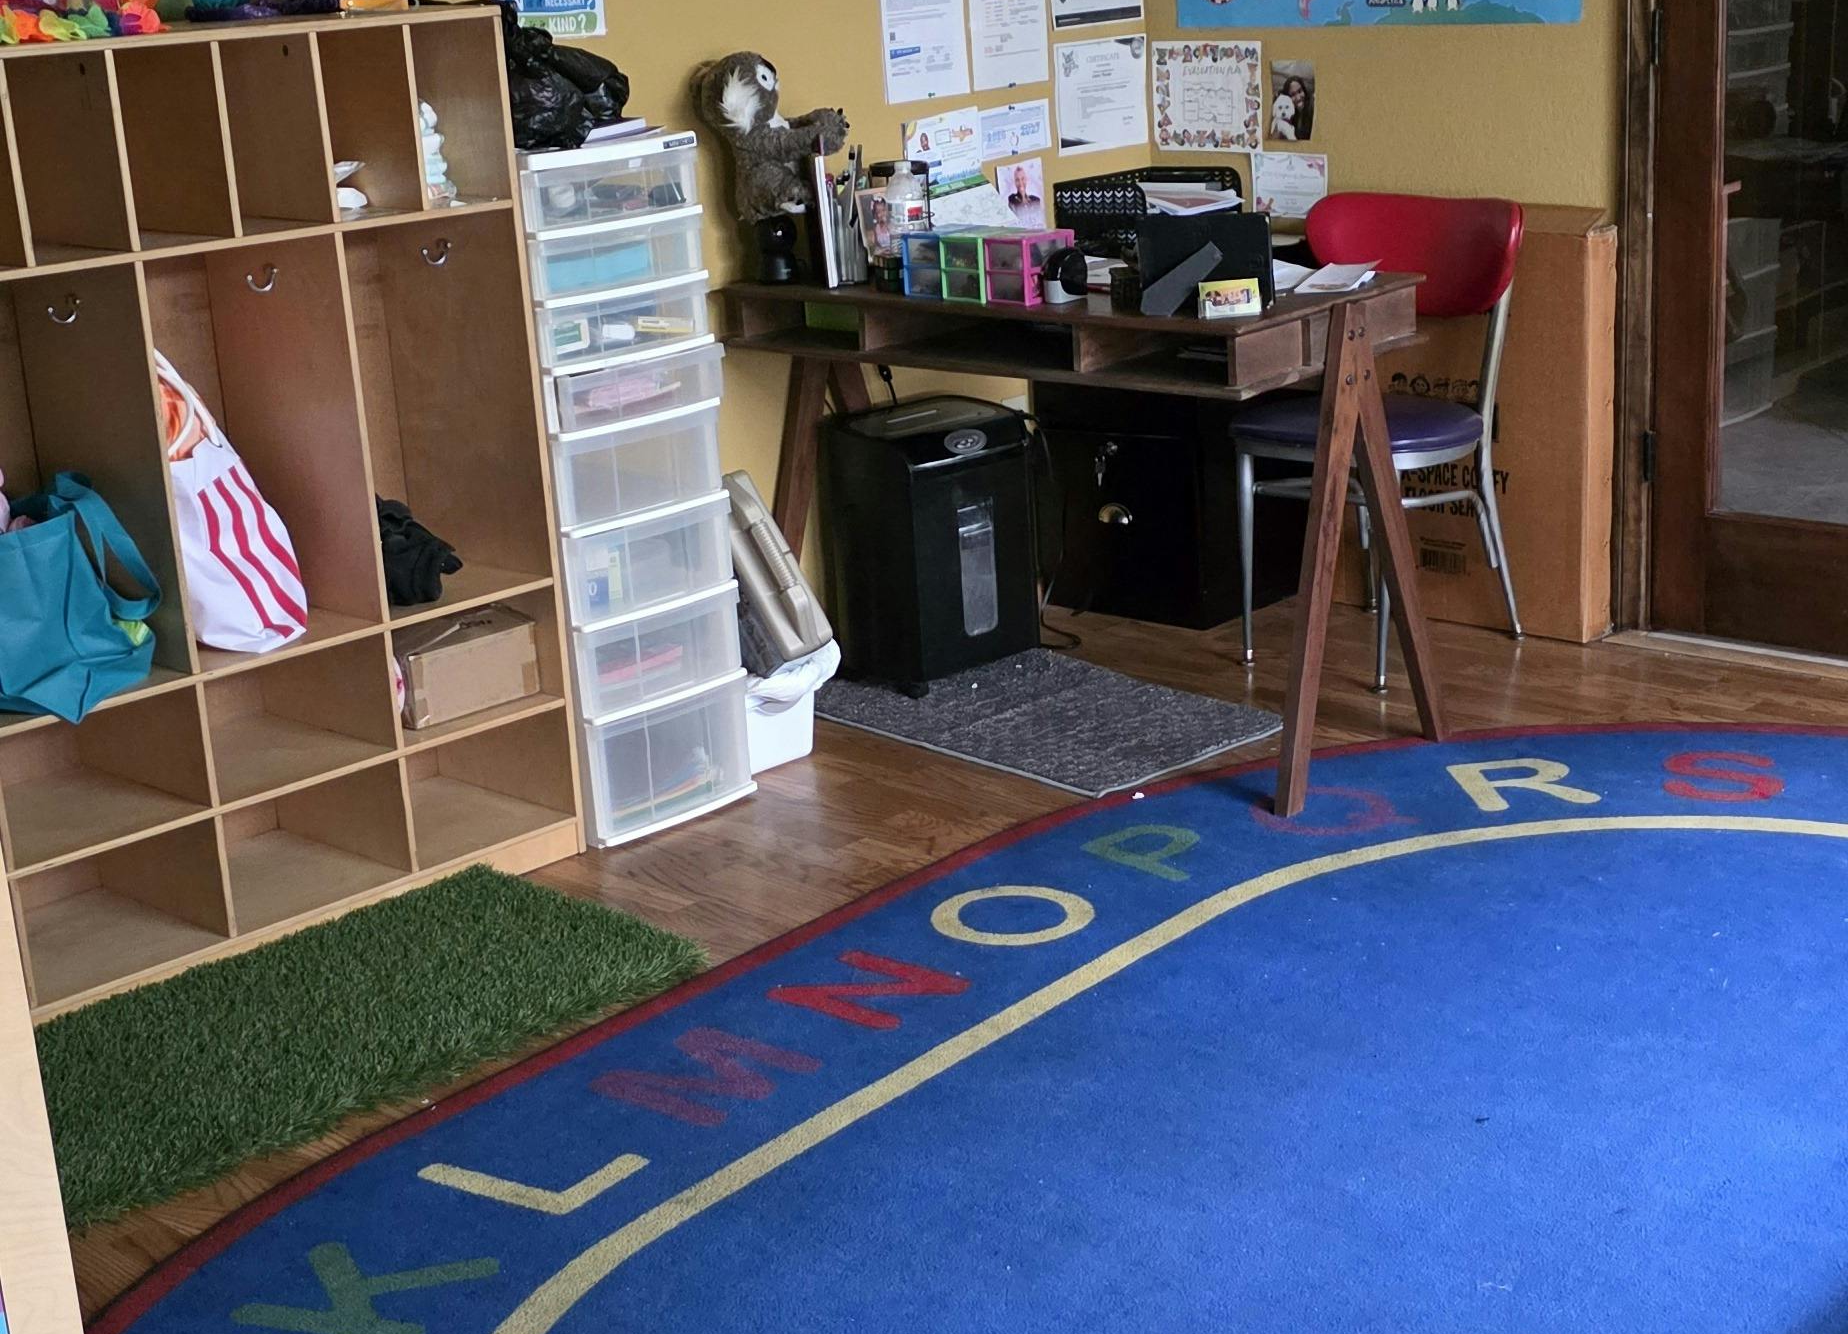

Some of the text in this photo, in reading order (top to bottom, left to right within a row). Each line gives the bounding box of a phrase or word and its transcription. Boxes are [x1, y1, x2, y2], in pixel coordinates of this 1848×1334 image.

[417, 1153, 650, 1215] L
[590, 1027, 822, 1127] M
[766, 950, 971, 1030] N
[930, 884, 1095, 947] O
[1081, 824, 1200, 882] P
[1446, 757, 1602, 812] R
[1663, 751, 1784, 803] S
